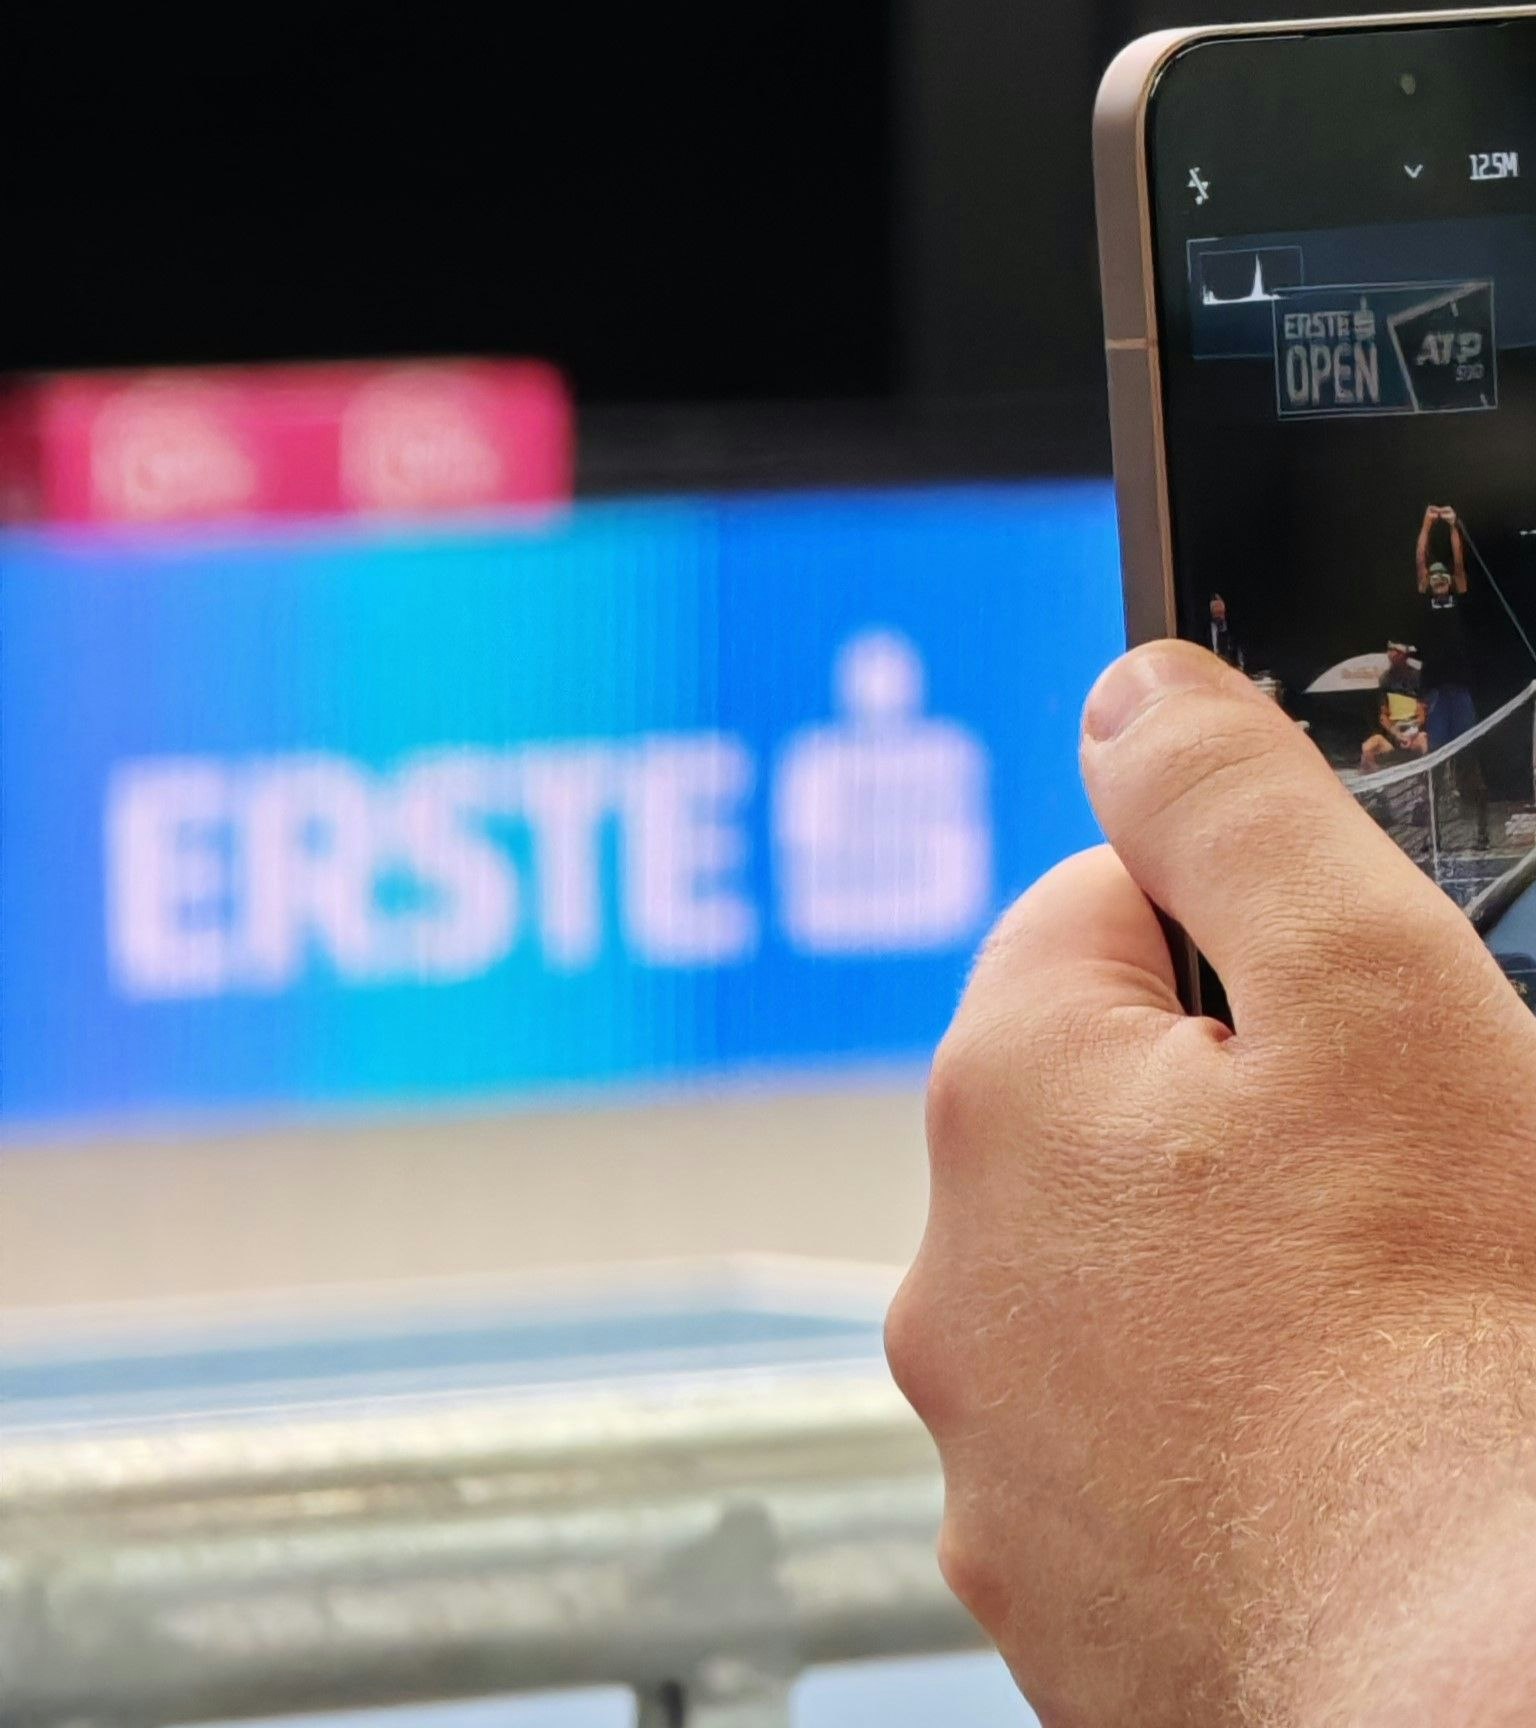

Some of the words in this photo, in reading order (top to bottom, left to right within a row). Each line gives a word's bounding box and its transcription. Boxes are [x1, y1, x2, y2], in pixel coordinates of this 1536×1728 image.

[1286, 342, 1380, 405] OPEN
[1416, 332, 1482, 365] ATP
[106, 732, 758, 998] ERSTE
